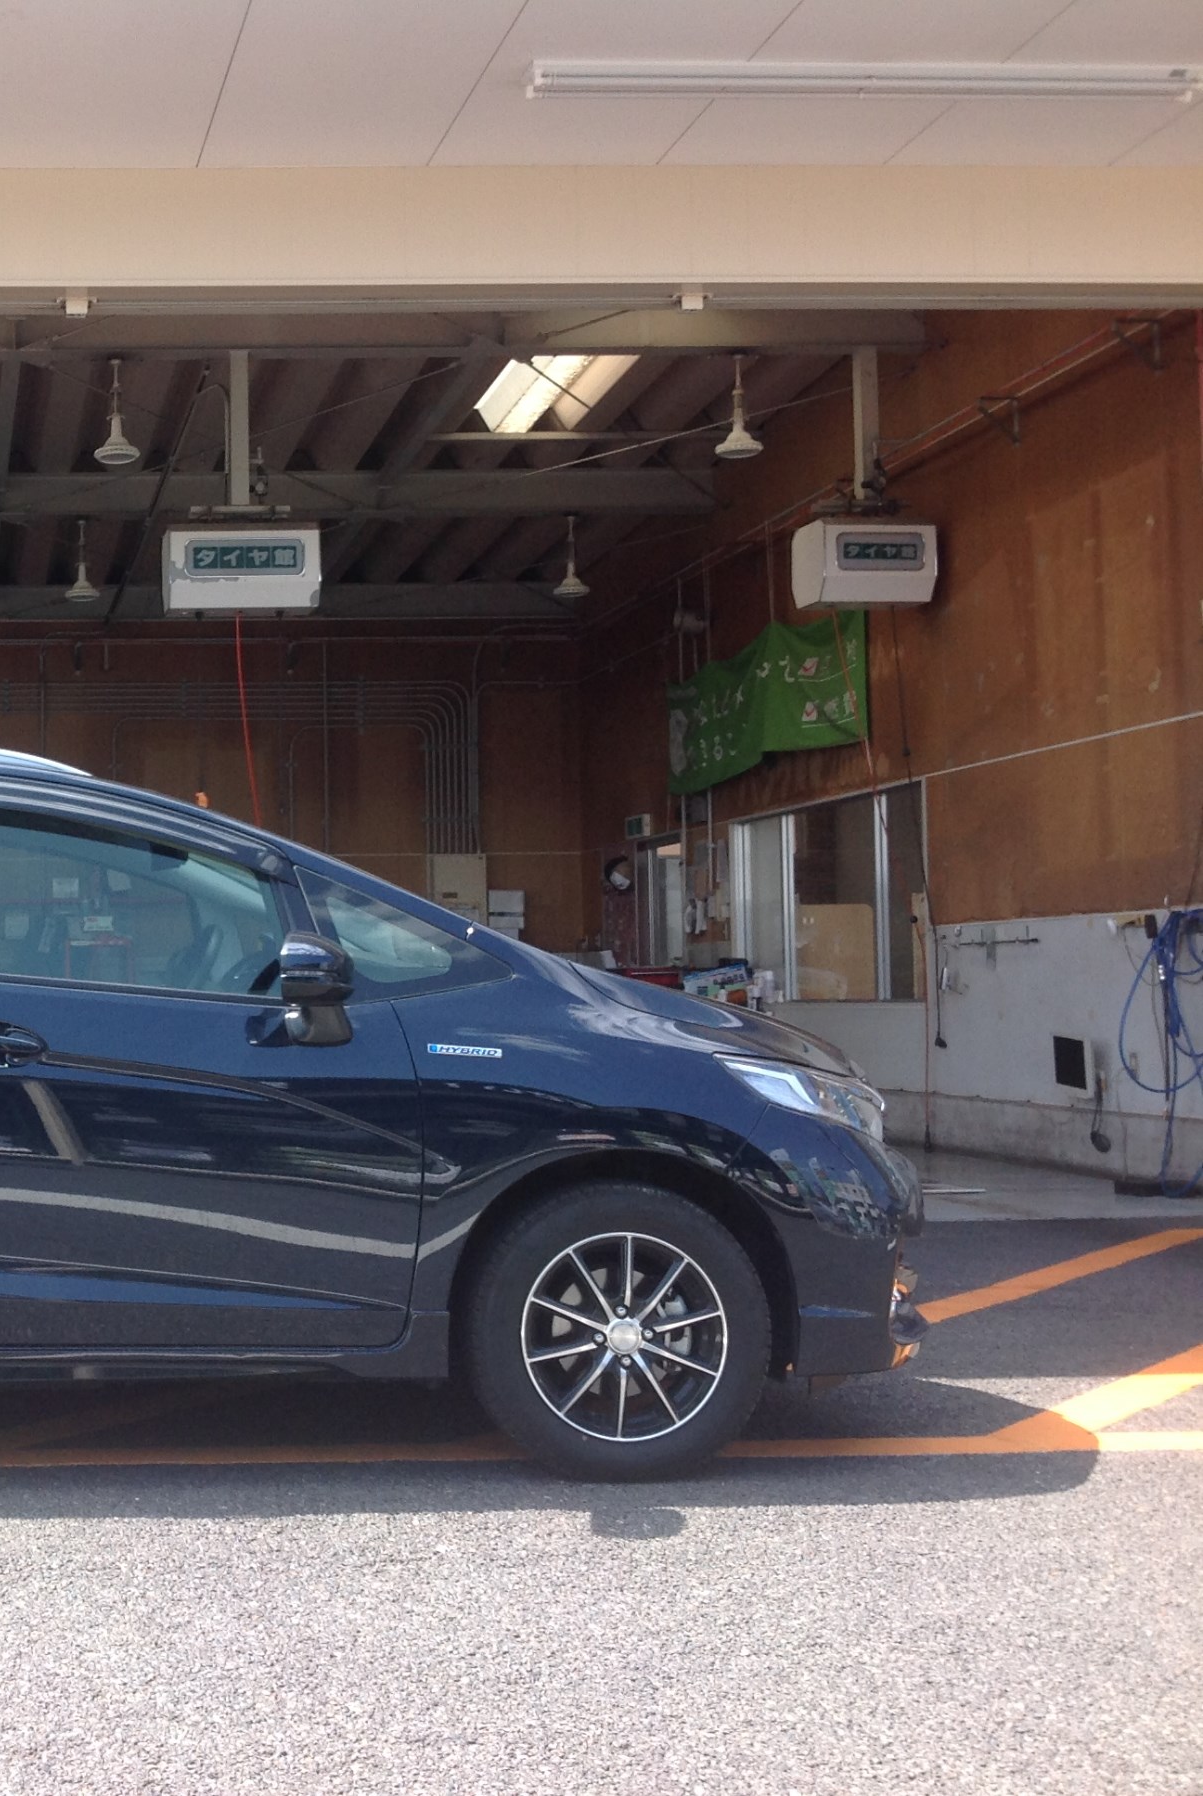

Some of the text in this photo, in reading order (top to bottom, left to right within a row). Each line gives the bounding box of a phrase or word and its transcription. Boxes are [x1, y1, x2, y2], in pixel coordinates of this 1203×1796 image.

[196, 548, 295, 566] タイヤ館
[438, 1045, 498, 1056] HYBRID
